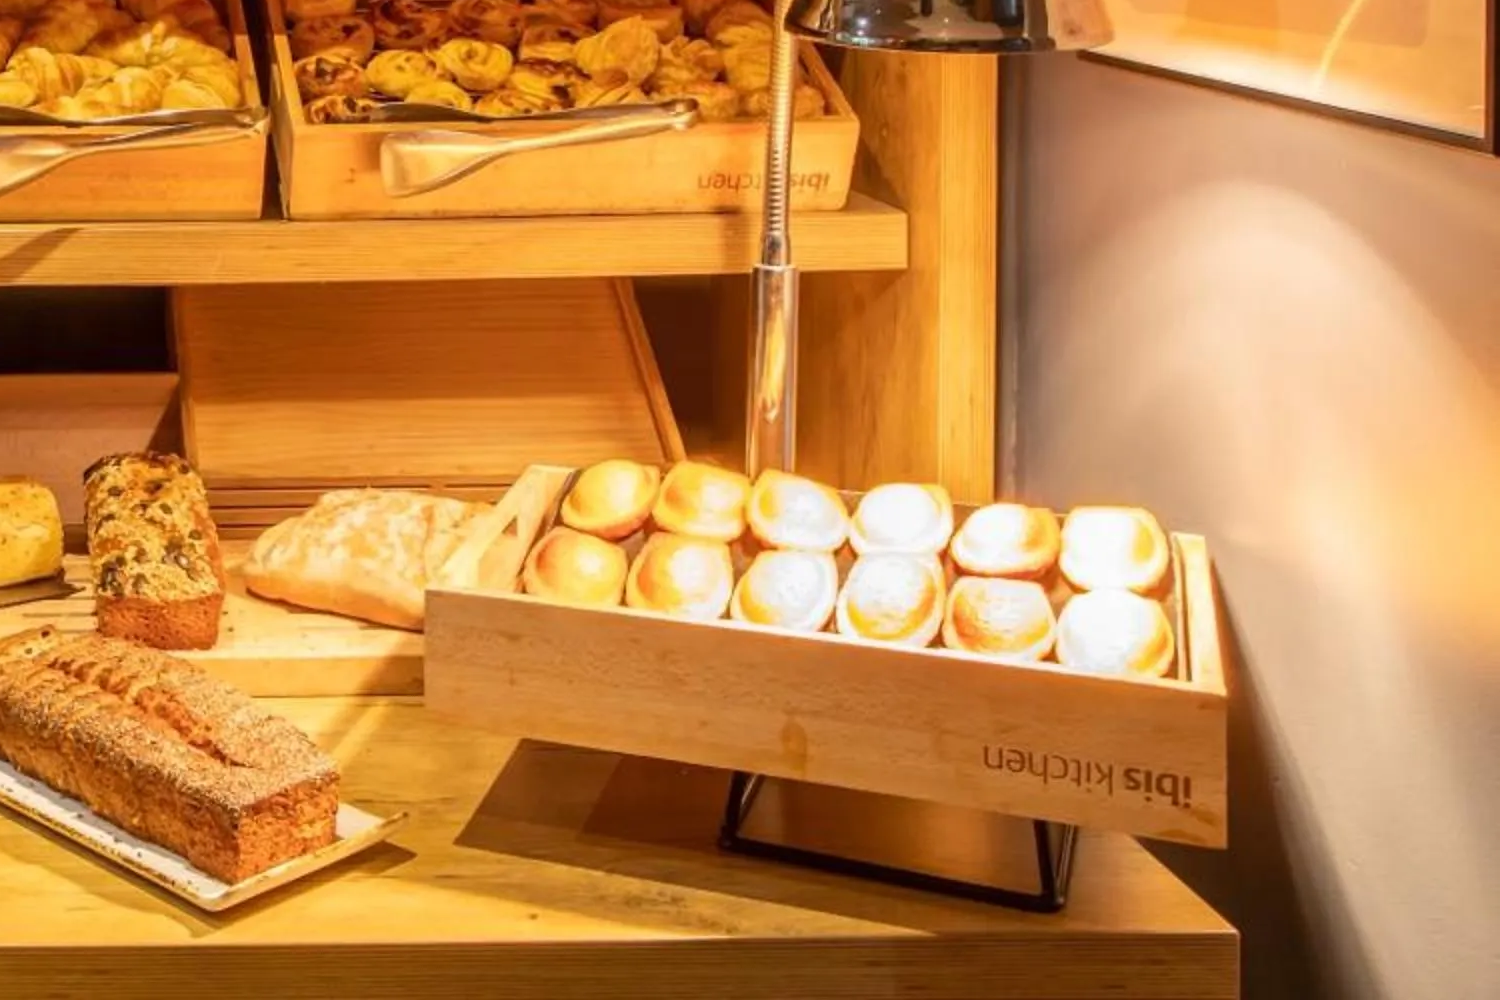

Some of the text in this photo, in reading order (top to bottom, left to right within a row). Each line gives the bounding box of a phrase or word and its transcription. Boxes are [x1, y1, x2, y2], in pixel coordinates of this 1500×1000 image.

[697, 171, 762, 192] tchen
[982, 744, 1193, 809] ibis kitchen
